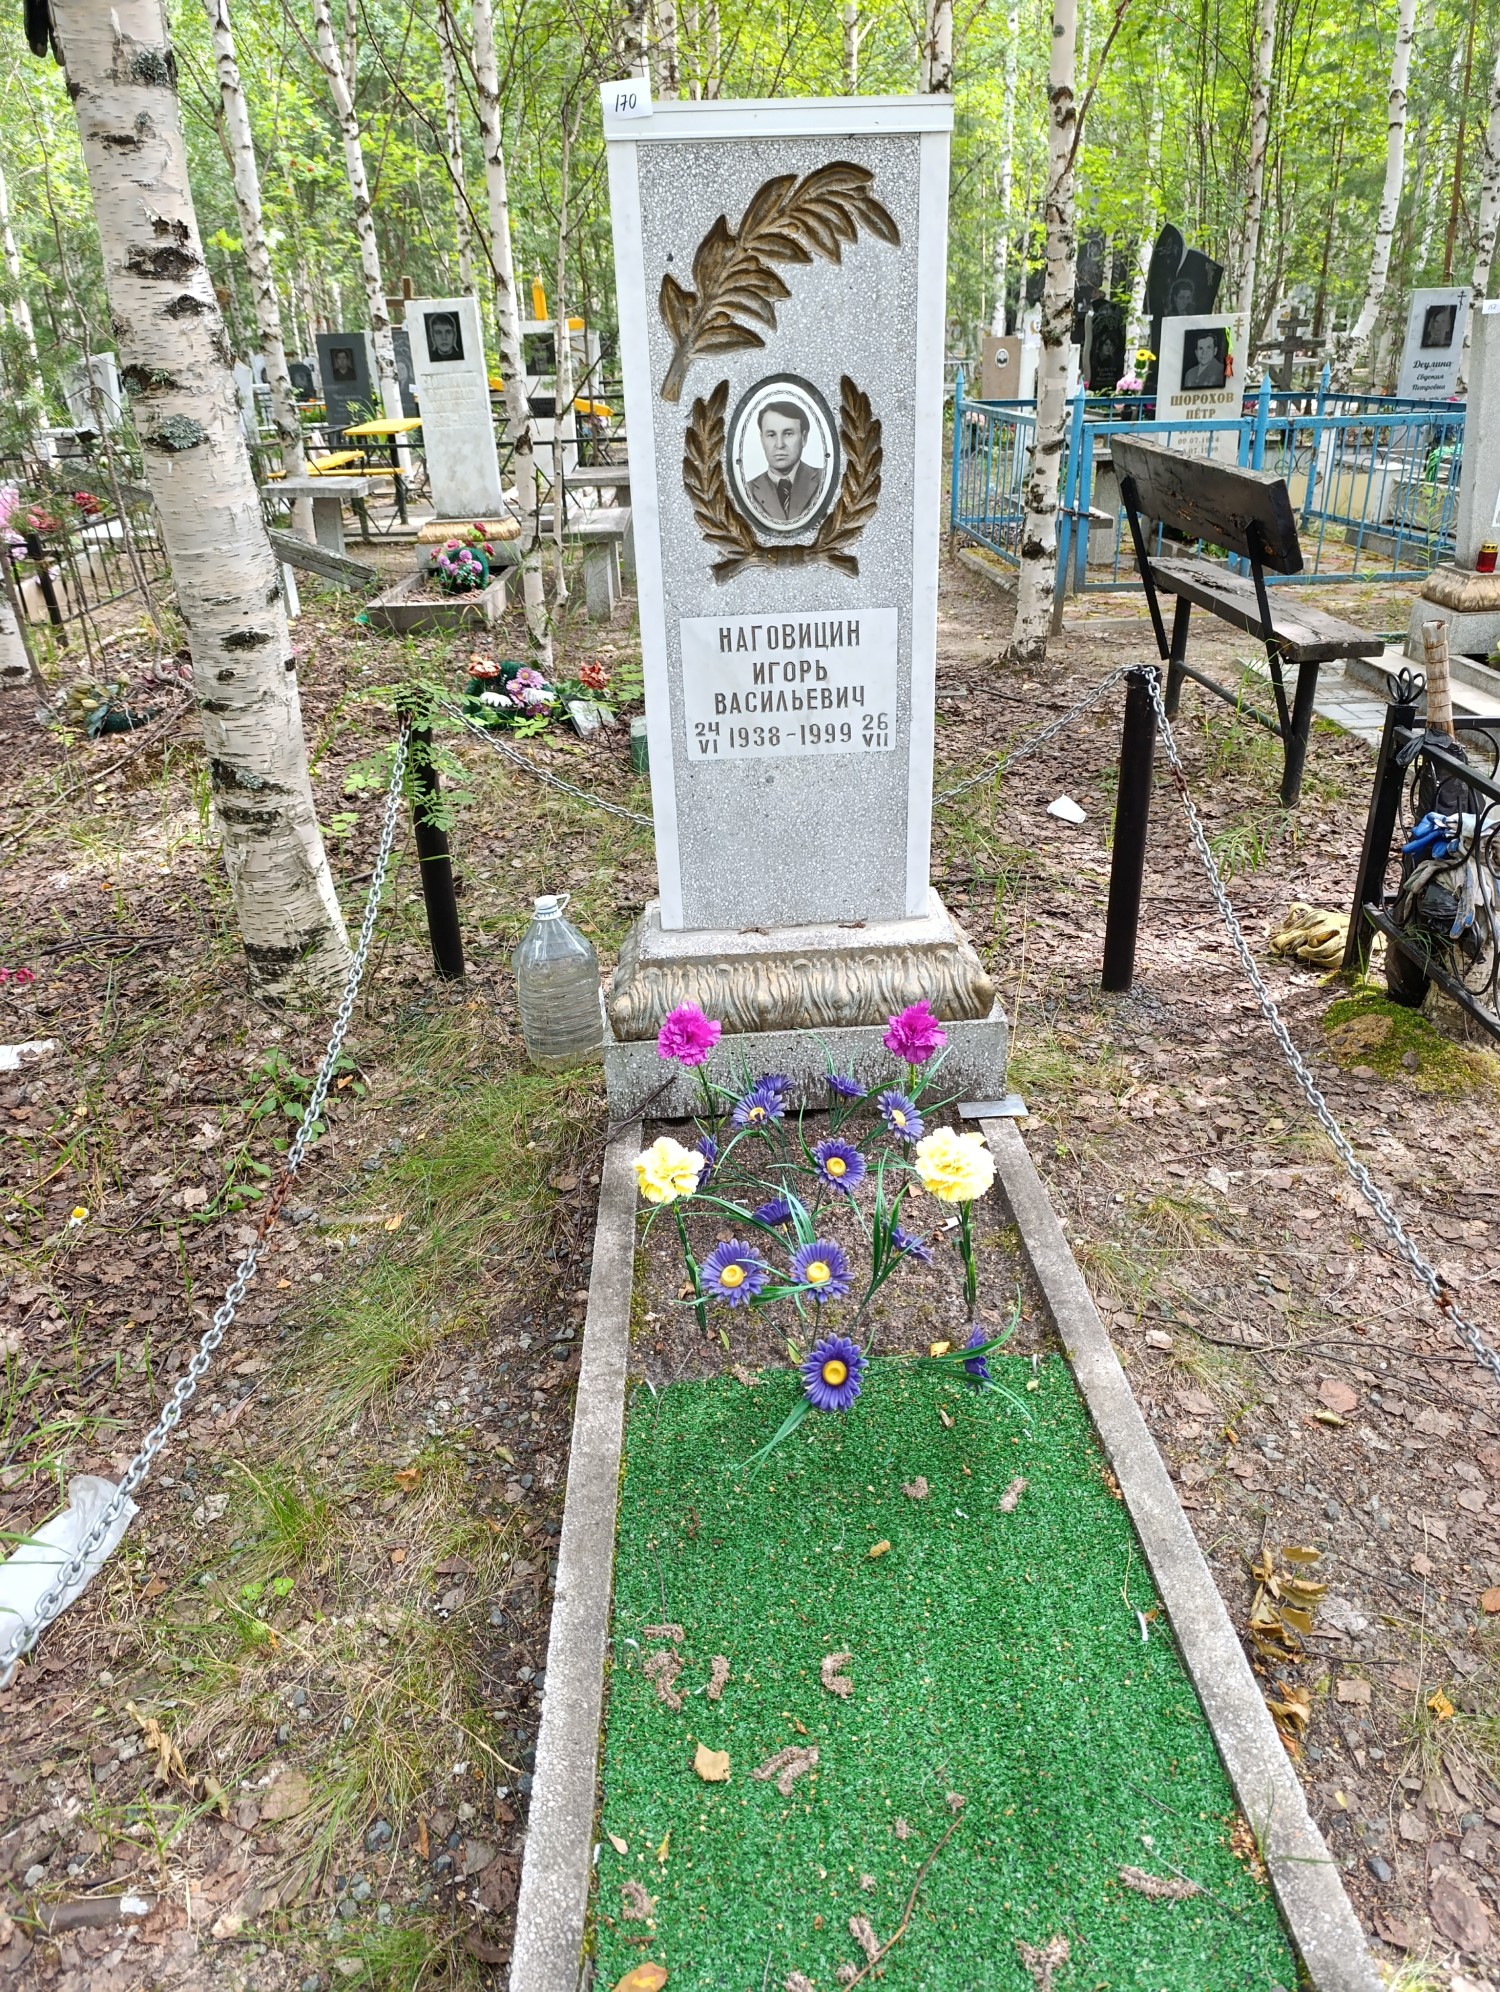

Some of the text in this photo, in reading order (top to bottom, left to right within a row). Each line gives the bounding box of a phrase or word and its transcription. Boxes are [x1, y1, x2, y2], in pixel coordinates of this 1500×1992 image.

[615, 93, 637, 112] 170
[1412, 360, 1452, 370] Деулина
[1412, 383, 1446, 391] Петровна
[1170, 392, 1234, 406] ШОРОХОВ
[719, 620, 860, 653] НАГОВИЦИН
[752, 659, 828, 685] ИГОРЬ
[714, 685, 865, 715] ВАСИЛЬЕВИЧ
[694, 721, 720, 737] 24
[861, 712, 889, 731] 26
[698, 732, 889, 754] VI VII
